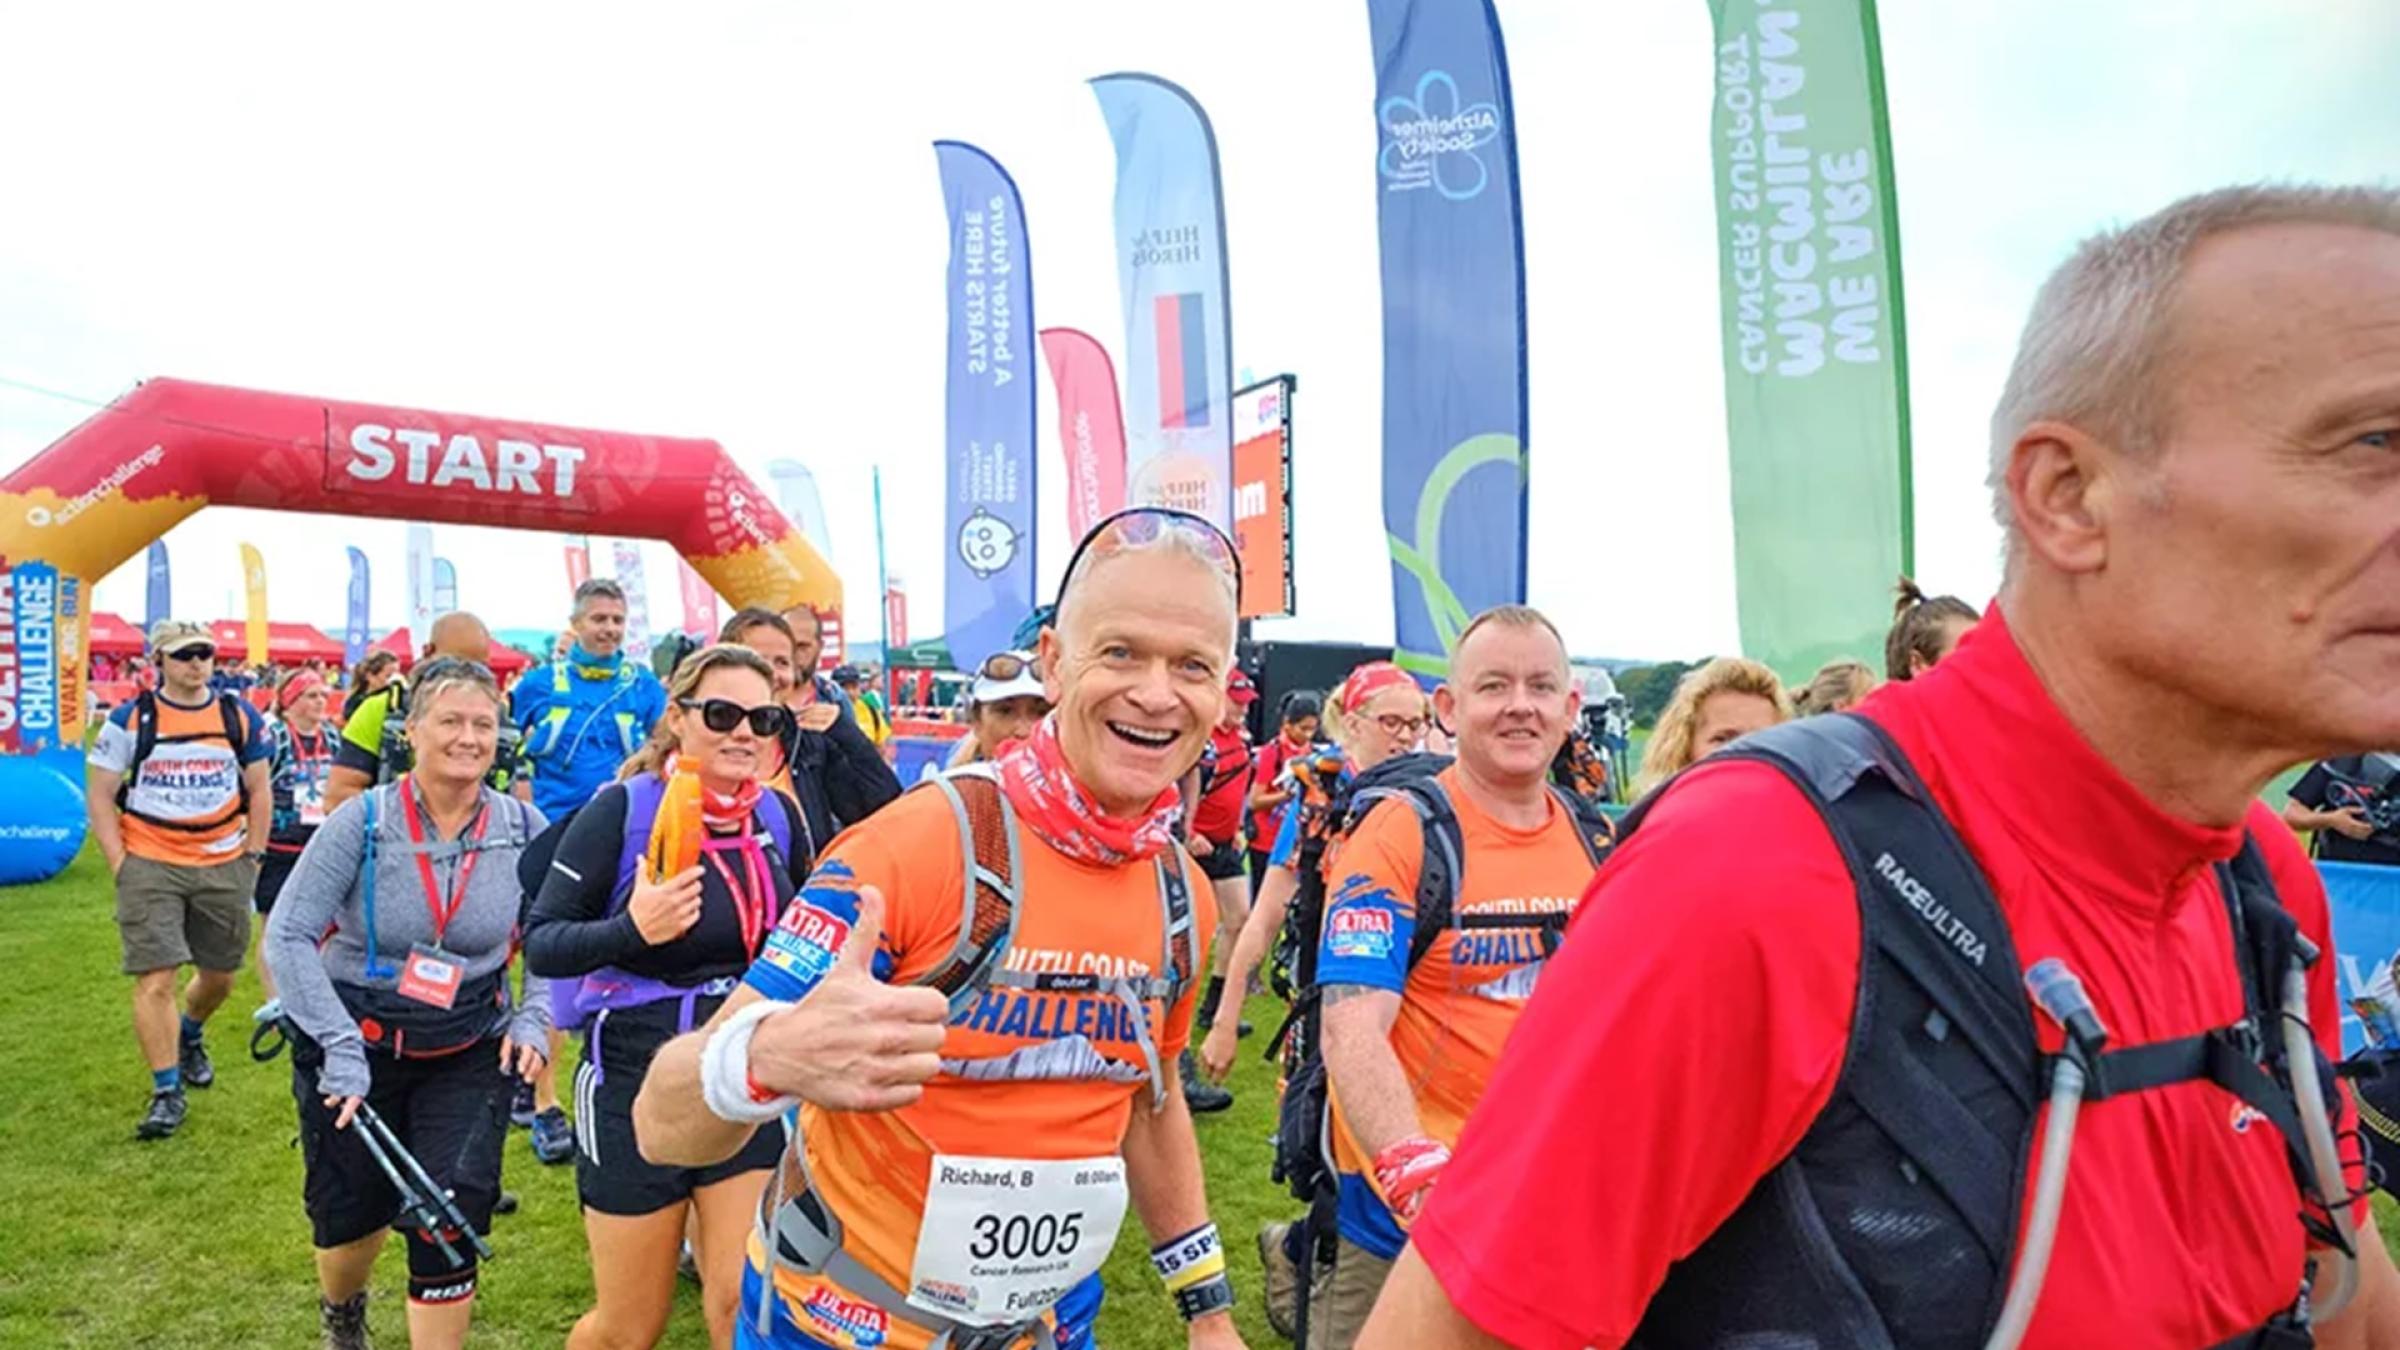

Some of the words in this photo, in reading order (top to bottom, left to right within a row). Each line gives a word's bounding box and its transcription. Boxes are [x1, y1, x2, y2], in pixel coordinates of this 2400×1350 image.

[346, 424, 586, 496] START
[20, 573, 52, 730] CHALLENGE
[60, 665, 78, 726] WALK
[1874, 851, 1986, 966] RACEULTRA
[940, 1165, 1015, 1188] Richard,
[1020, 1171, 1034, 1187] B
[969, 1211, 1084, 1260] 3005
[970, 1264, 1009, 1277] Cancer
[1011, 1263, 1054, 1276] Research
